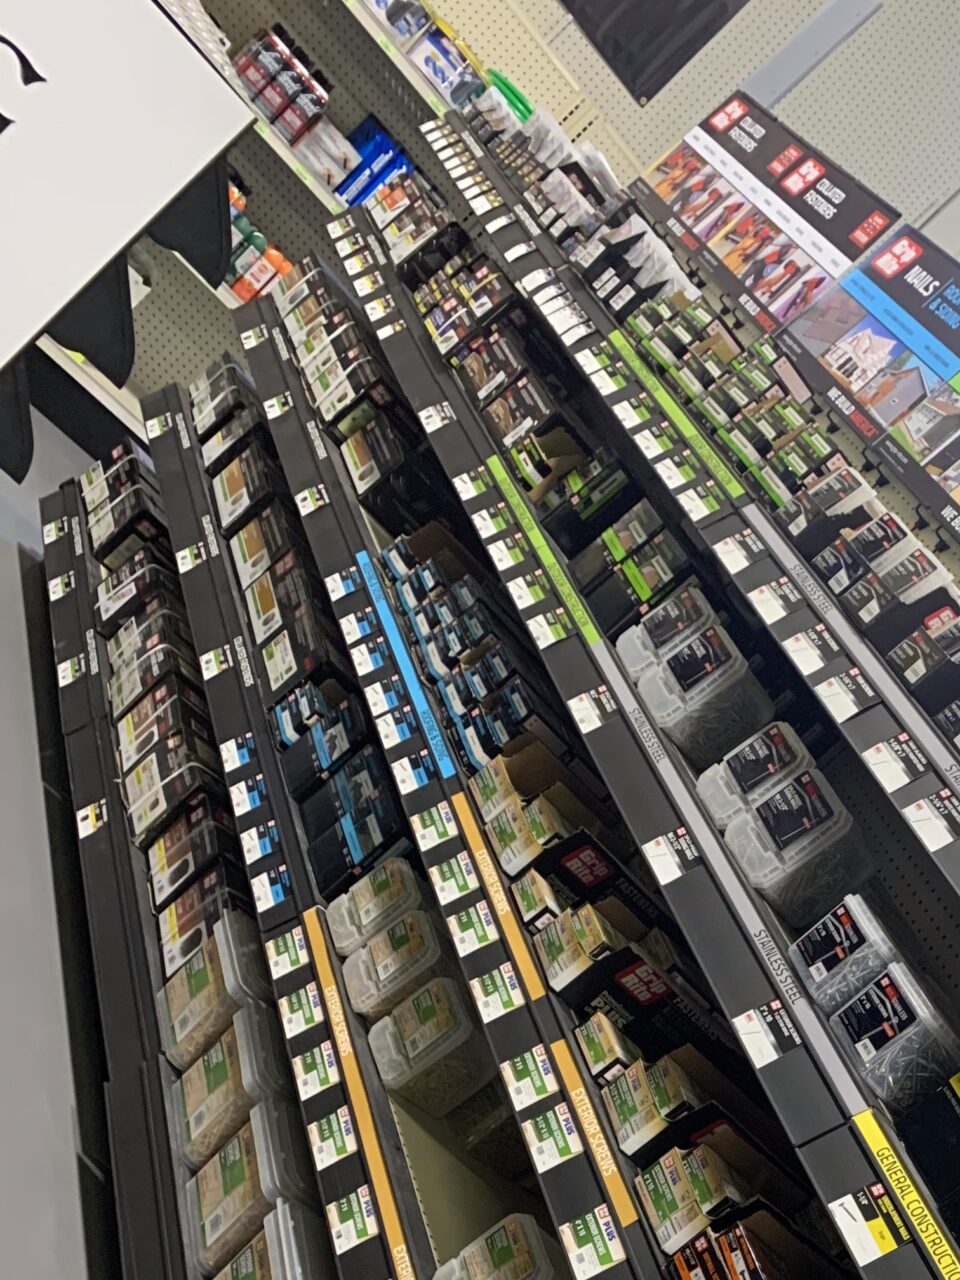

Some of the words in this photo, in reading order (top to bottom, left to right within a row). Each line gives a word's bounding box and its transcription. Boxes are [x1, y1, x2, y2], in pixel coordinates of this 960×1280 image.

[903, 265, 941, 297] NAILS
[940, 505, 954, 520] WE
[628, 706, 655, 743] STAINLESS
[647, 739, 666, 763] STEEL
[474, 848, 498, 885] EXTERIOR
[487, 881, 510, 916] SCREWS
[751, 926, 790, 978] STAINLESS
[777, 973, 805, 1006] STEEL
[560, 1115, 576, 1137] PLUS
[570, 1085, 600, 1136] EXTERIOR
[588, 1132, 616, 1177] SCREWS
[874, 1144, 915, 1201] GENERAL
